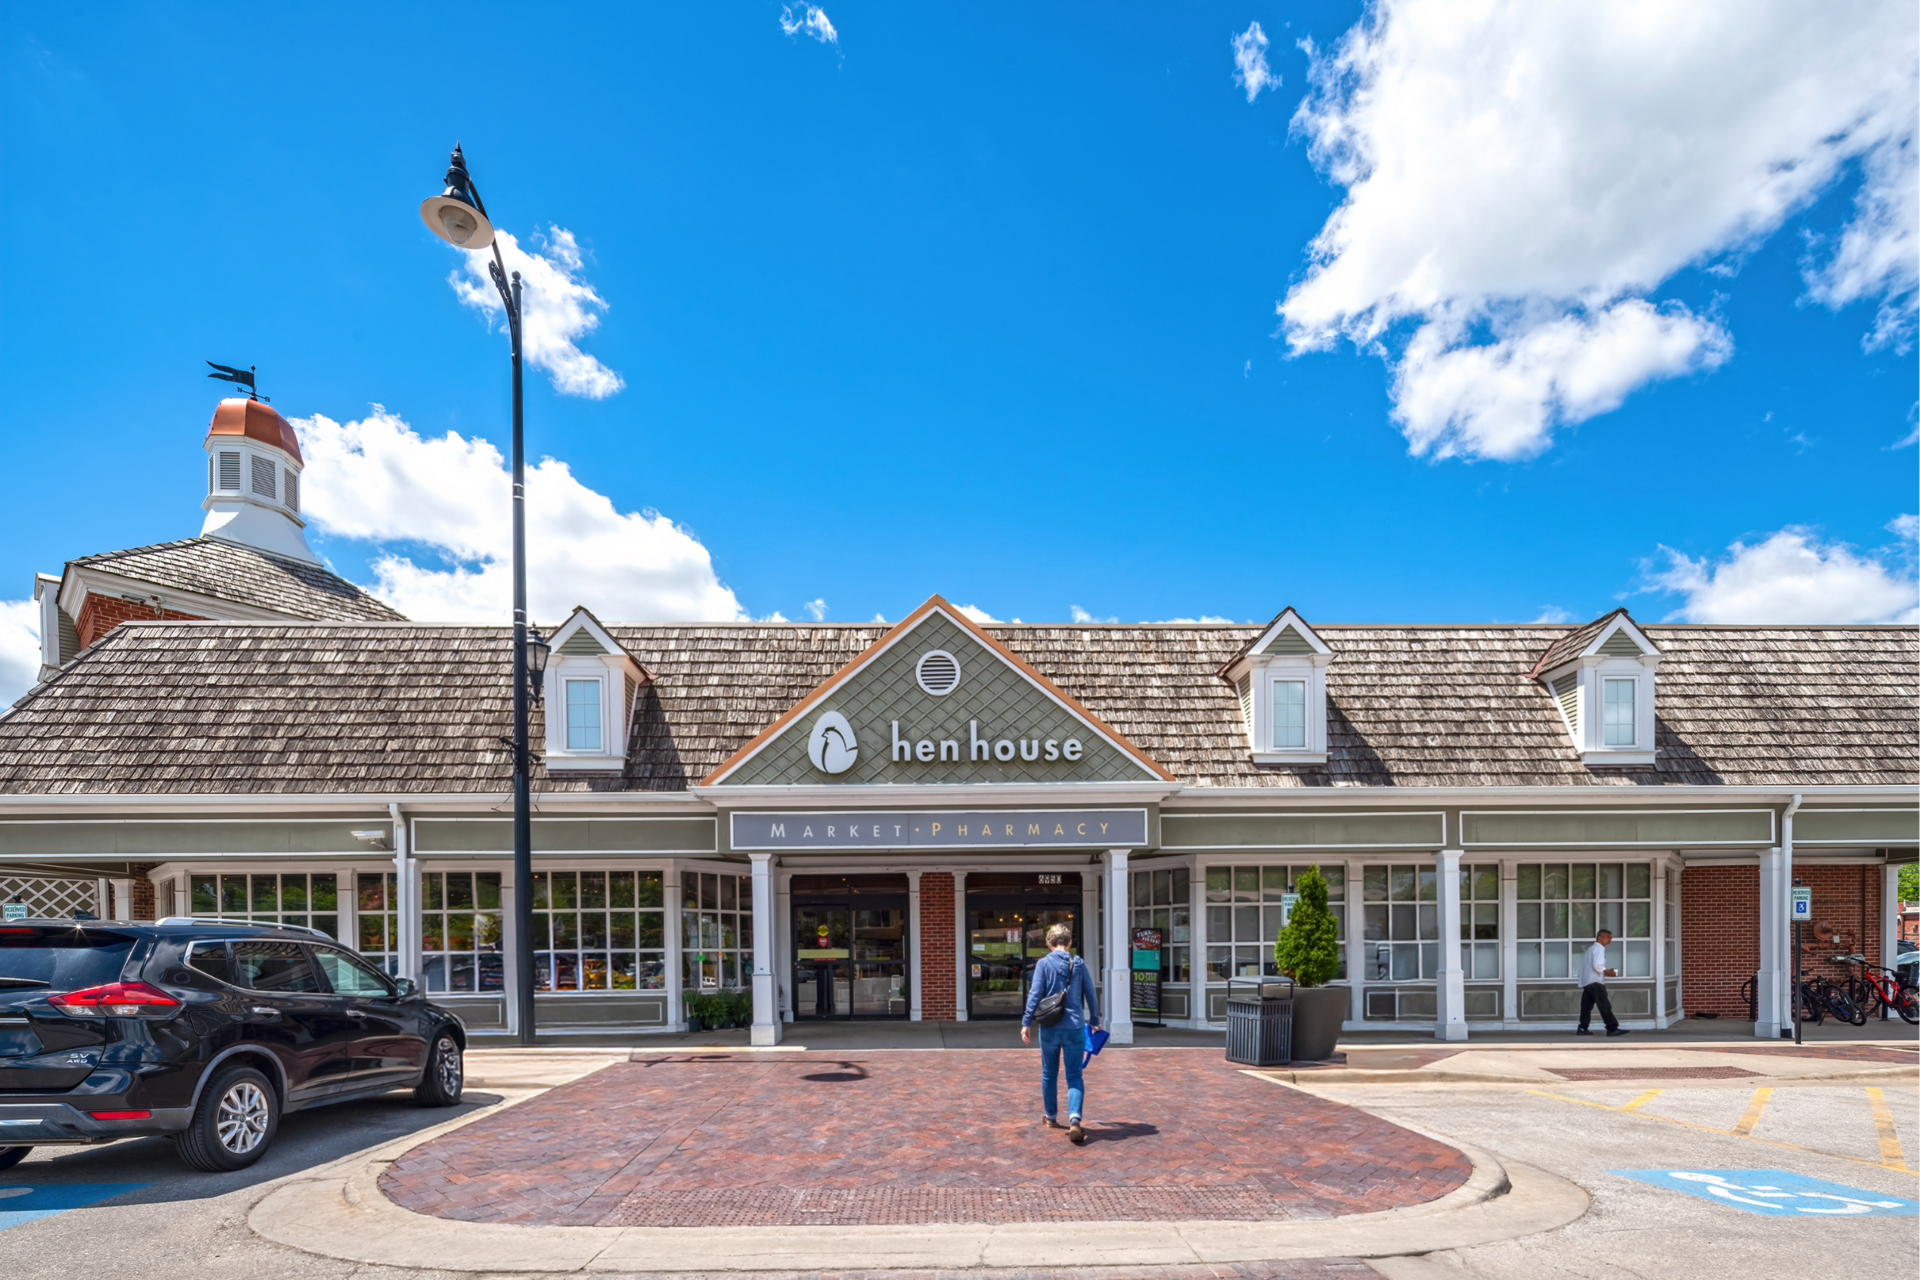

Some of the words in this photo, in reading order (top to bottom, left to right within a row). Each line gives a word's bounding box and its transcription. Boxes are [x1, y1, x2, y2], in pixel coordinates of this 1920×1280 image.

[891, 720, 960, 762] hen
[970, 719, 1083, 762] house
[770, 823, 901, 838] MARKET
[932, 822, 1109, 836] PHARMACY
[1133, 972, 1145, 981] 10
